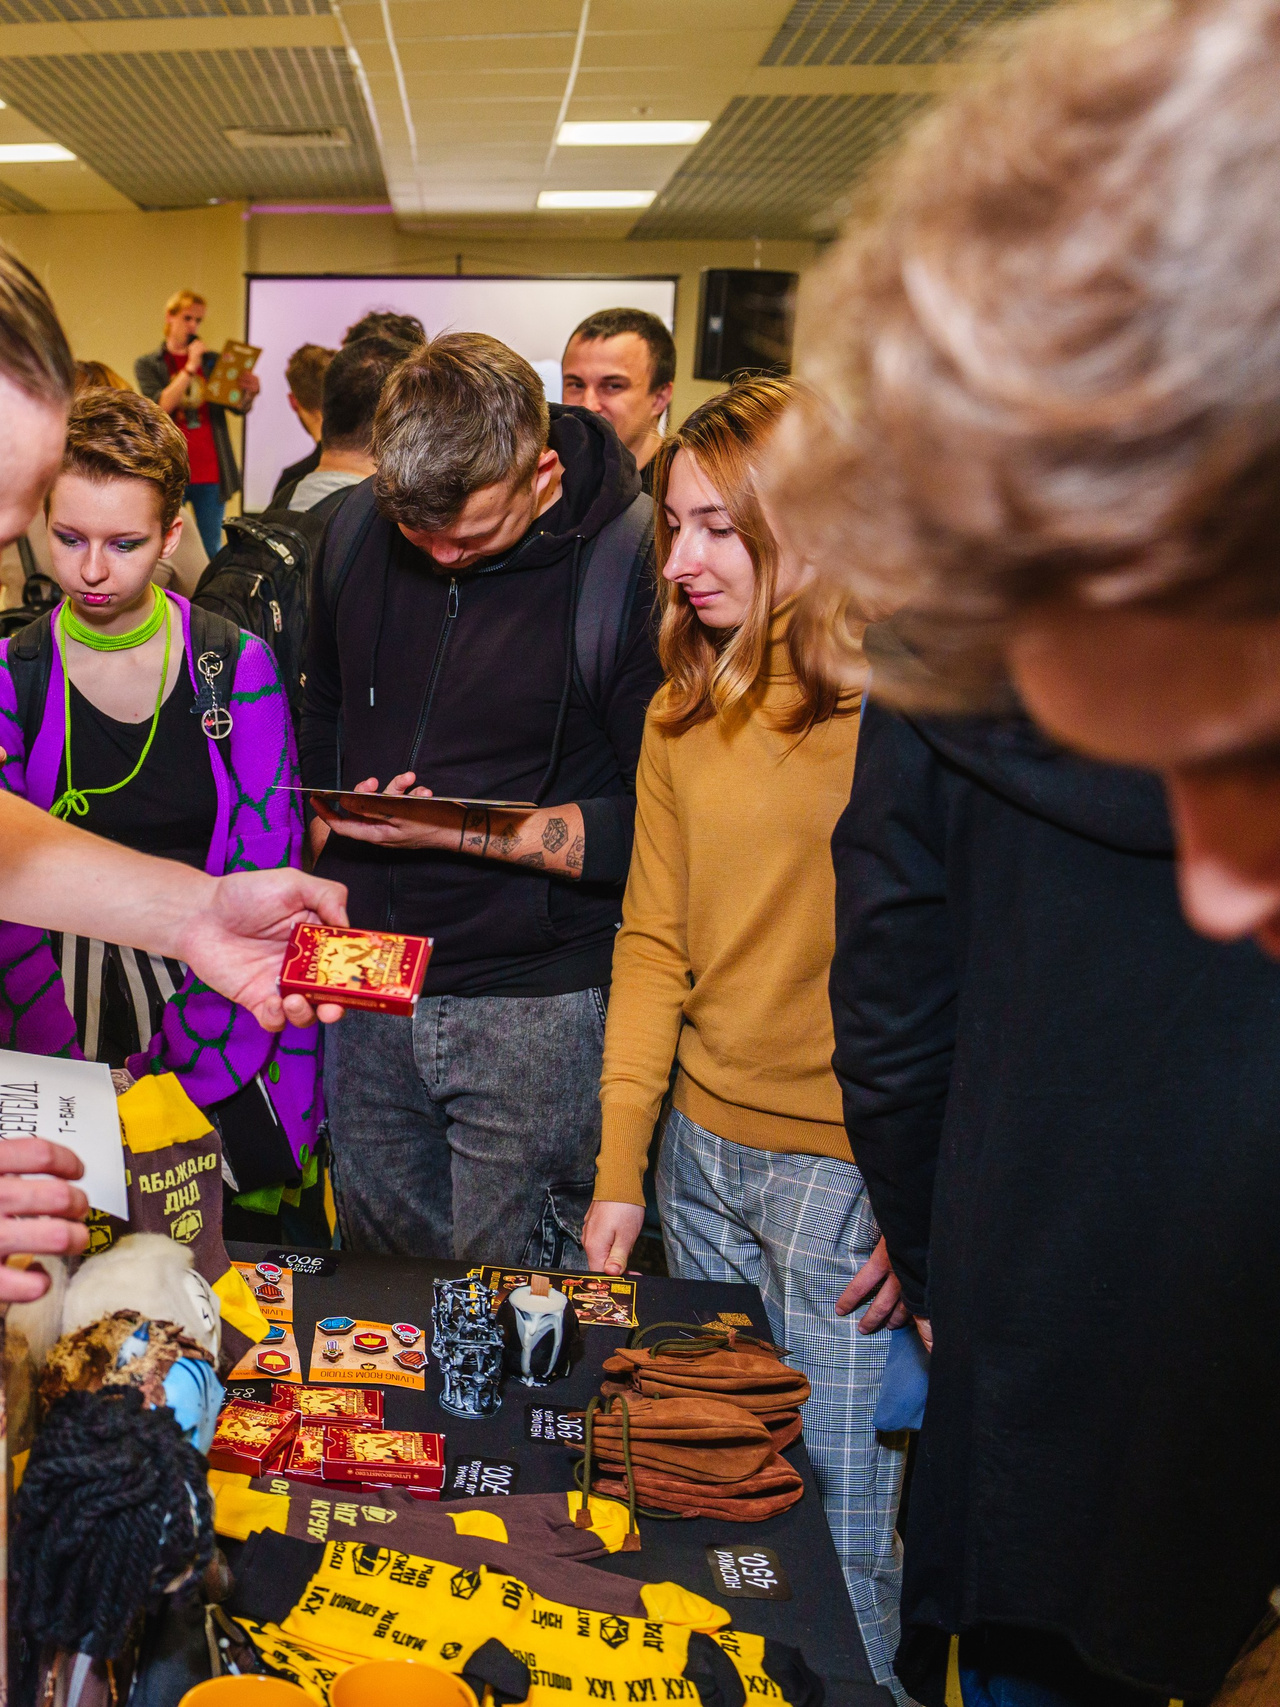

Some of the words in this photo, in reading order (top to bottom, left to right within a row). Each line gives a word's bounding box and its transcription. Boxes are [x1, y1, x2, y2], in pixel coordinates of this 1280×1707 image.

[138, 1153, 217, 1194] АБАЖАЮ
[163, 1180, 201, 1215] ДНД
[261, 1307, 284, 1316] LIVIN
[320, 1370, 353, 1379] STUDIO
[353, 1372, 383, 1381] ROOM
[385, 1373, 416, 1384] LIVING
[307, 1499, 332, 1542] АБАЖ
[333, 1502, 360, 1527] ДН
[400, 1568, 420, 1586] НИ
[372, 1609, 400, 1639] ВОЛК
[391, 1629, 428, 1652] МАТЬ
[585, 1676, 616, 1702] ХУ!
[624, 1679, 656, 1702] ХУ!
[661, 1677, 695, 1699] ХУ!
[744, 1674, 779, 1698] ХУ!
